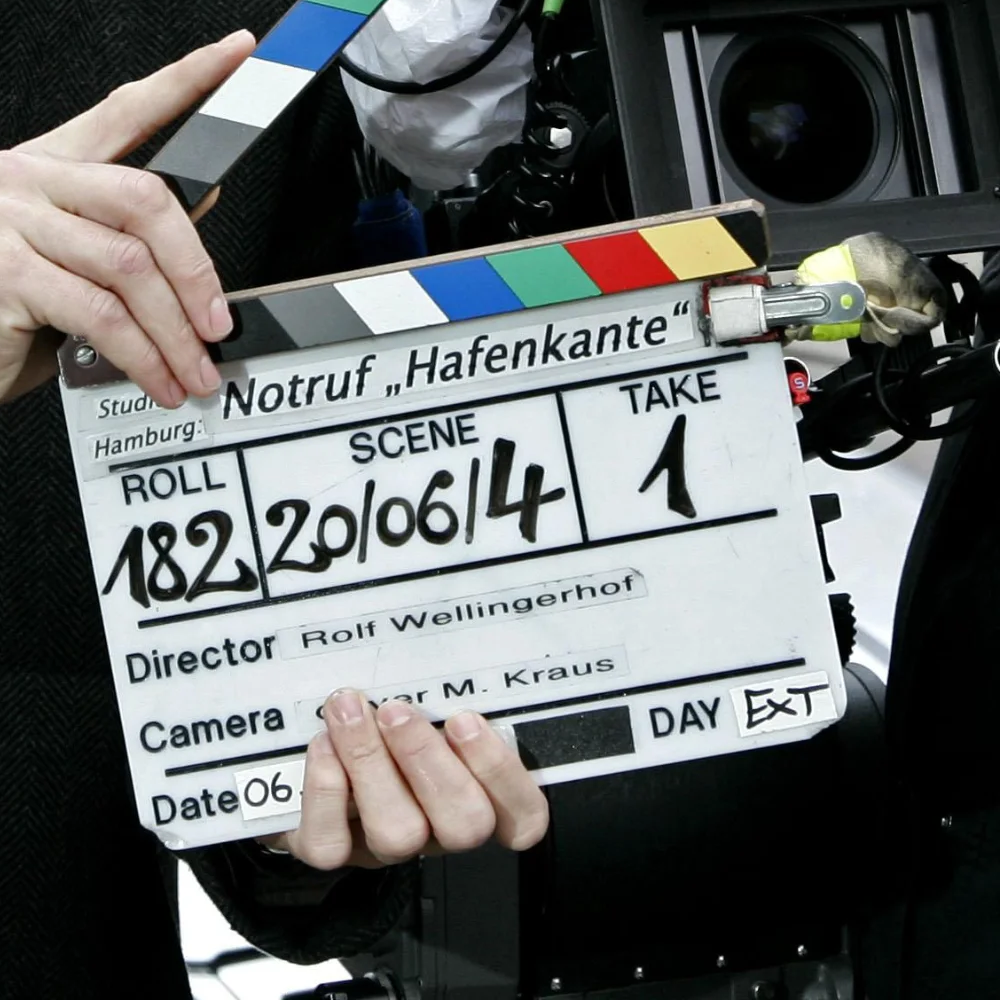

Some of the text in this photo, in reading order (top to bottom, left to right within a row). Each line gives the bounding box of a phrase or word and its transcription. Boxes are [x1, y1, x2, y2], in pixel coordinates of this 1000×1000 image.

[222, 300, 691, 421] Notruf „Hafenkante“
[98, 391, 162, 419] Studi
[619, 370, 722, 415] TAKE
[94, 419, 203, 459] Hamburg:
[349, 413, 480, 465] SCENE
[121, 461, 227, 506] ROLL
[637, 414, 697, 519] 1
[265, 437, 567, 575] 20/06/4
[101, 509, 259, 609] 182
[125, 575, 637, 685] Director Rolf Wellingerhof
[139, 704, 286, 754] Camera
[442, 678, 489, 701] M.
[503, 655, 616, 690] Kraus
[649, 697, 721, 739] DAY
[151, 788, 240, 827] Date
